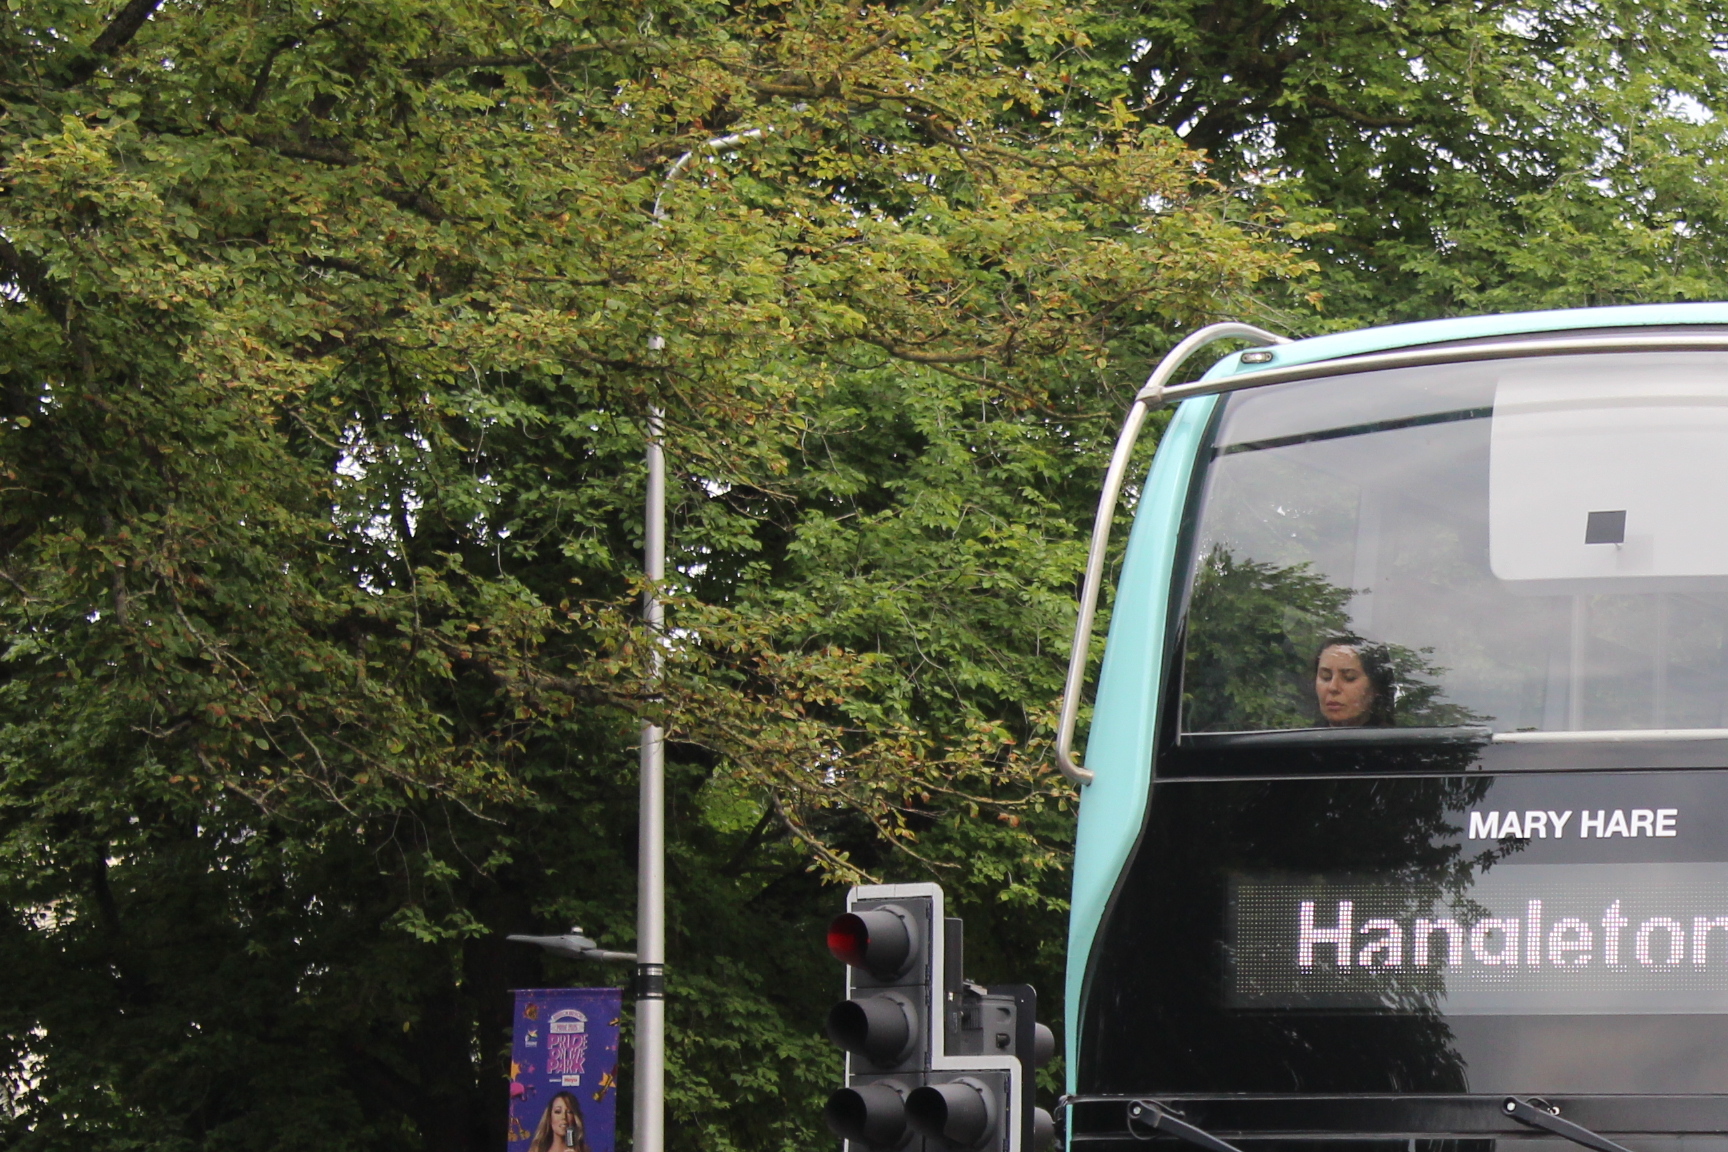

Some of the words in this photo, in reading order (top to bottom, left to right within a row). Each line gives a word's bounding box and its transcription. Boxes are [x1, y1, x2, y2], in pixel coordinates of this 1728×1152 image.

[1468, 810, 1573, 840] MARY
[1580, 808, 1678, 839] HARE
[547, 1033, 589, 1050] PRIDE
[546, 1058, 586, 1075] PARK
